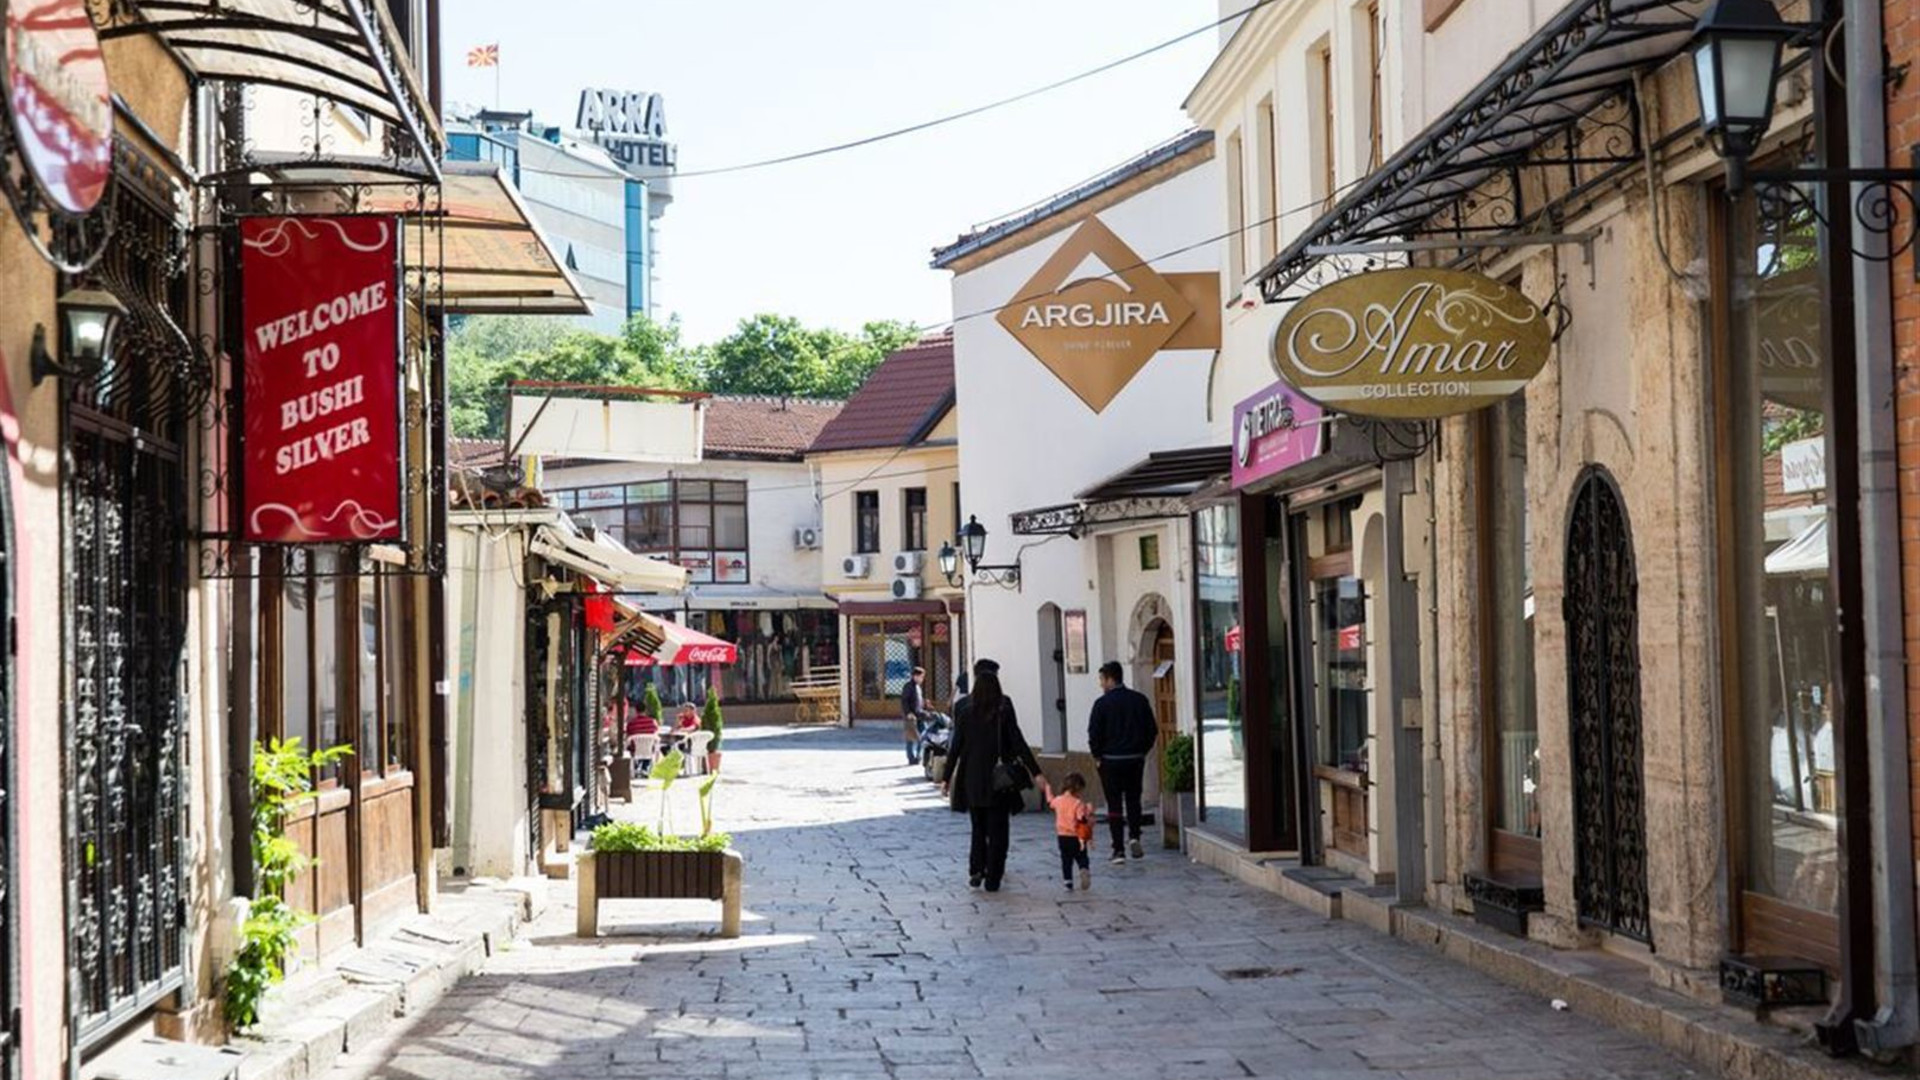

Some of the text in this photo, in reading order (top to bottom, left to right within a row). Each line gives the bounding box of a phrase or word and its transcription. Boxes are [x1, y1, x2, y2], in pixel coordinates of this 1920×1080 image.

[576, 87, 667, 137] ARKA
[255, 281, 387, 353] WELCOME
[1021, 302, 1170, 329] ARGJIRA
[1288, 282, 1519, 377] Amar
[303, 343, 340, 378] TO
[281, 375, 364, 430] BUSHI
[1361, 381, 1470, 398] COLLECTION
[276, 417, 370, 475] SILVER
